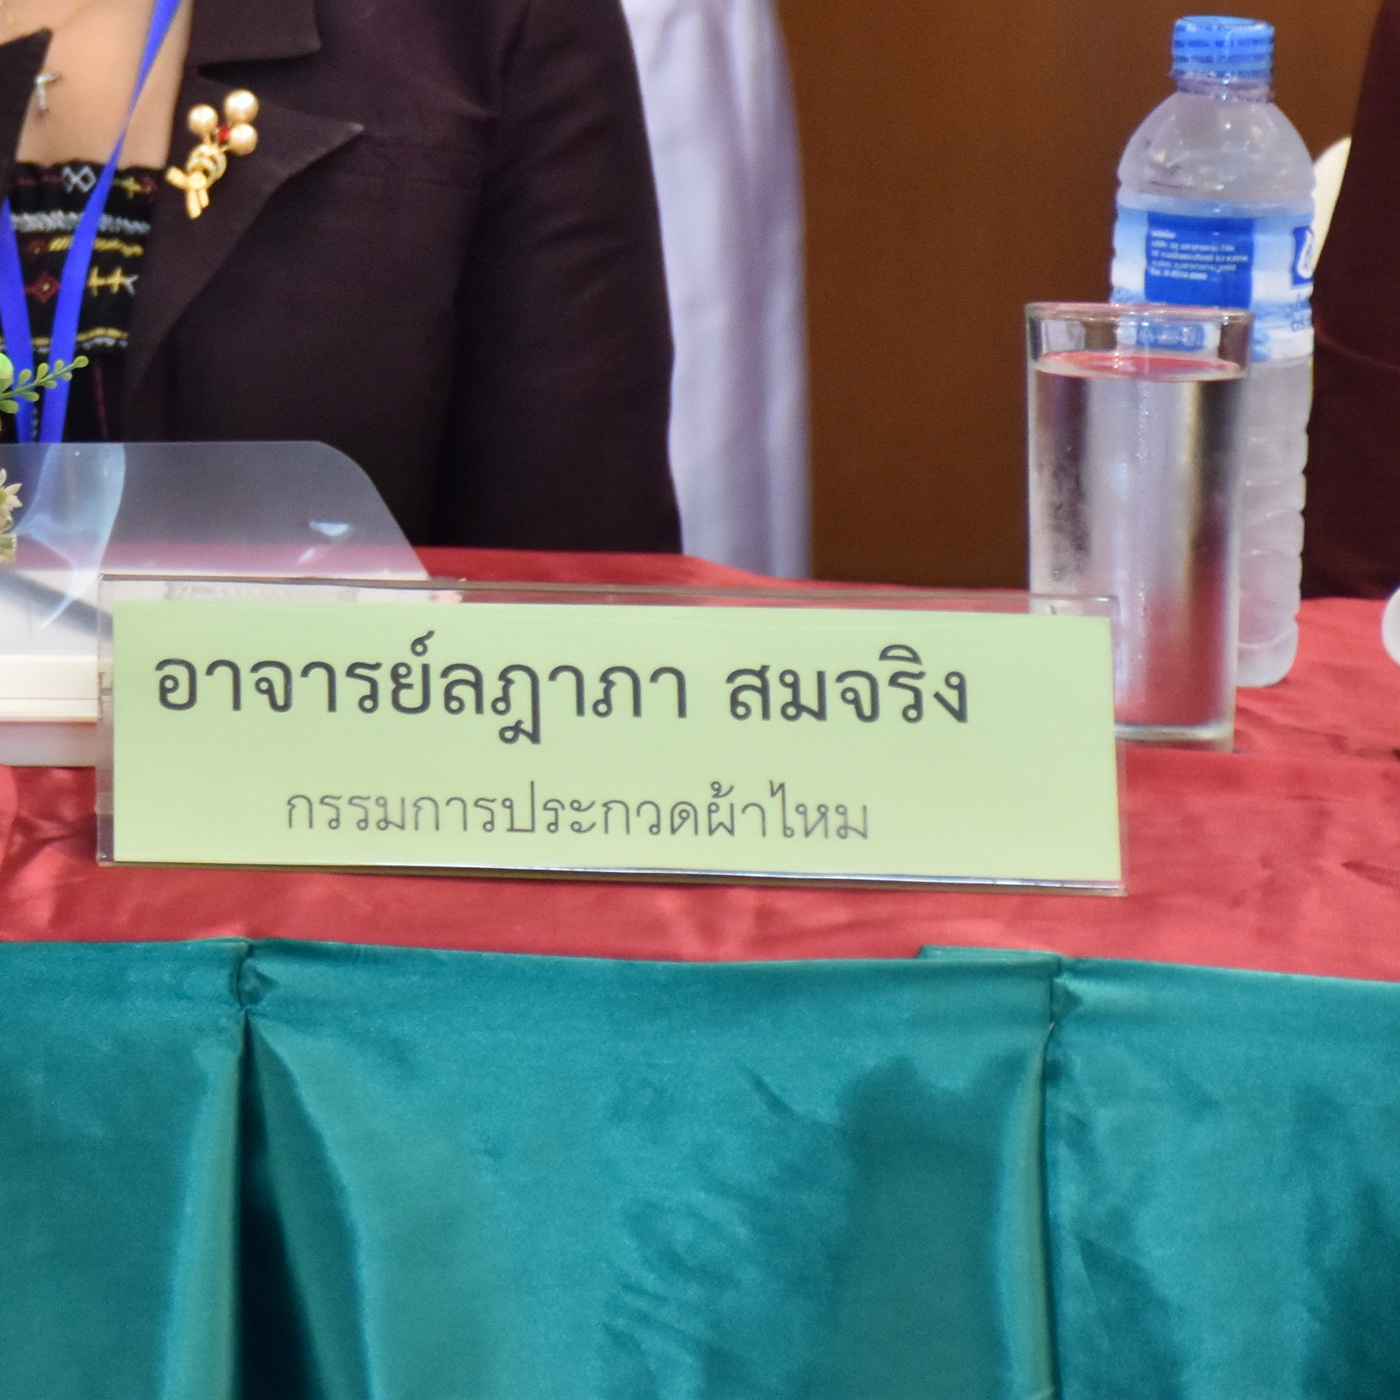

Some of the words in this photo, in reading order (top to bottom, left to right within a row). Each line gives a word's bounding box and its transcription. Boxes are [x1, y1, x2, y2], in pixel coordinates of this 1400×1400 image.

[725, 644, 968, 724] สมจริง
[286, 780, 868, 840] กรรมการประกวดผ้าไหม
